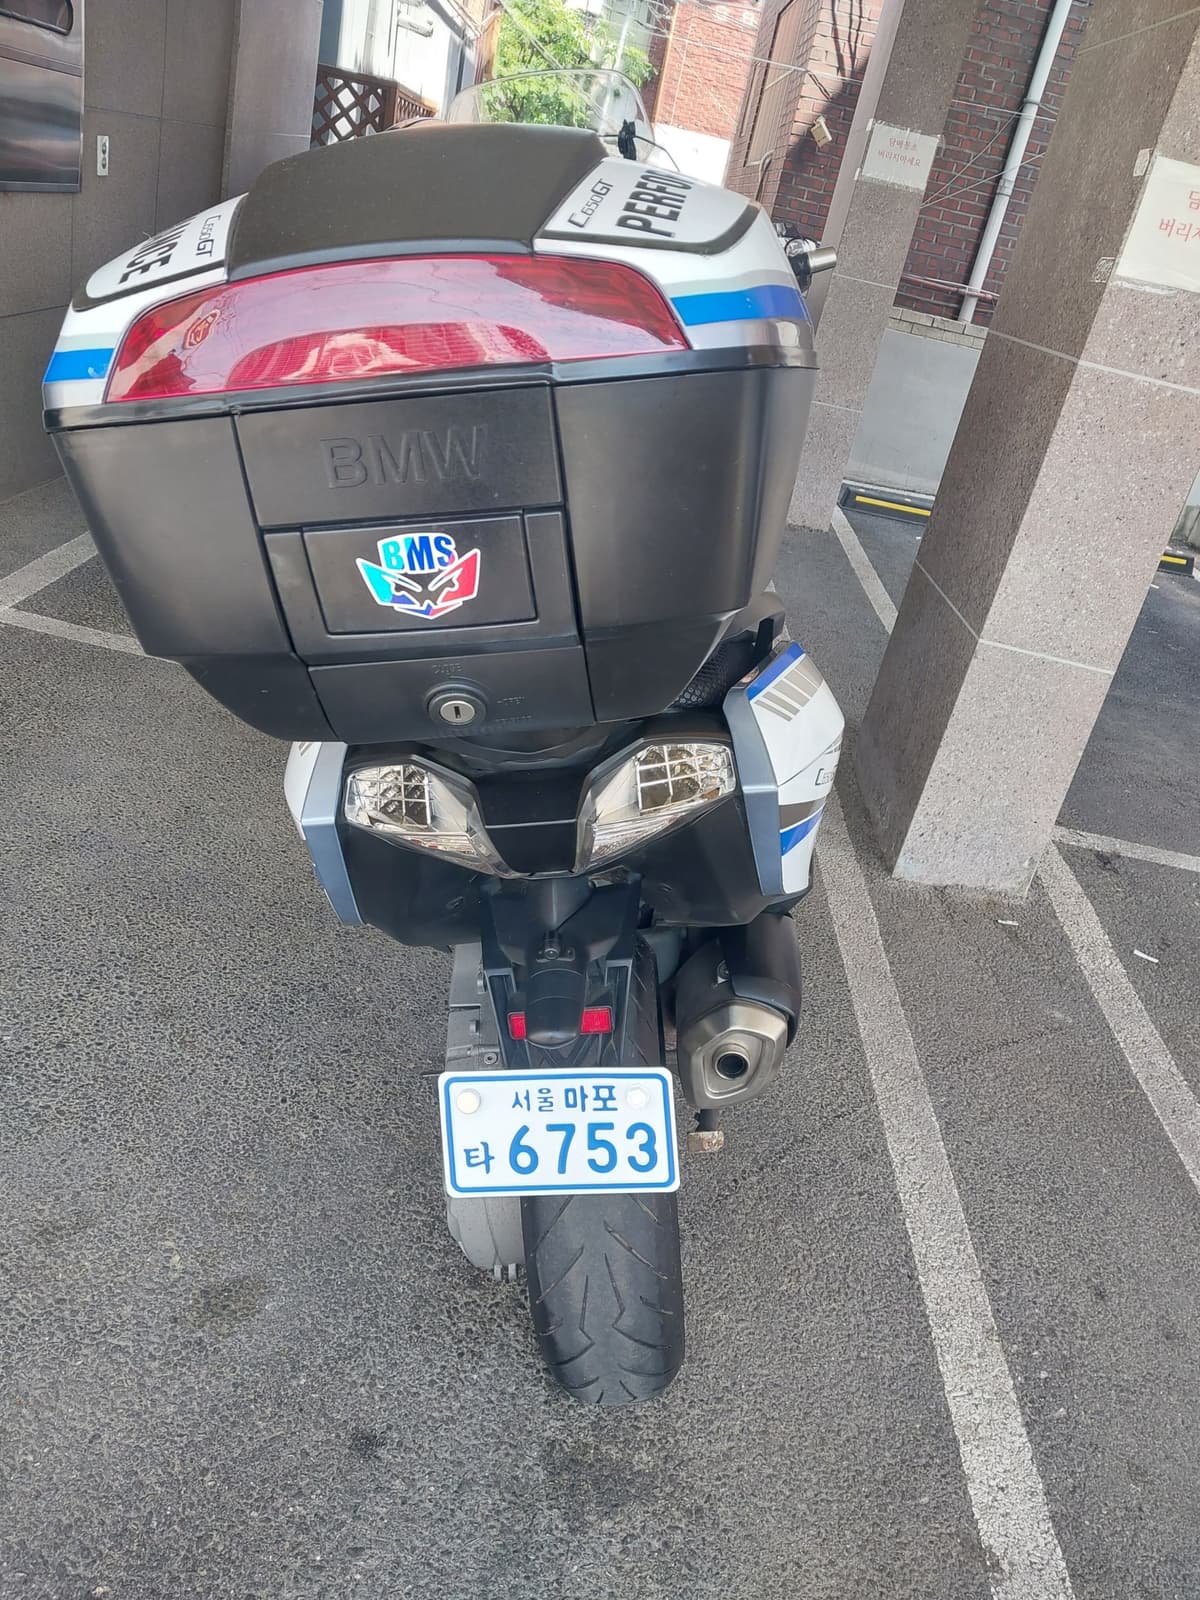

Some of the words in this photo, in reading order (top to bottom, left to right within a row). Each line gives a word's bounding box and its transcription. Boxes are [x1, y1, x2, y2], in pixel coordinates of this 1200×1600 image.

[568, 178, 613, 228] C650GT
[320, 425, 486, 489] BMW
[382, 535, 455, 571] BMS
[512, 1088, 554, 1112] 서울
[565, 1085, 618, 1112] 마포
[464, 1141, 495, 1174] 타
[509, 1122, 658, 1175] 6753
